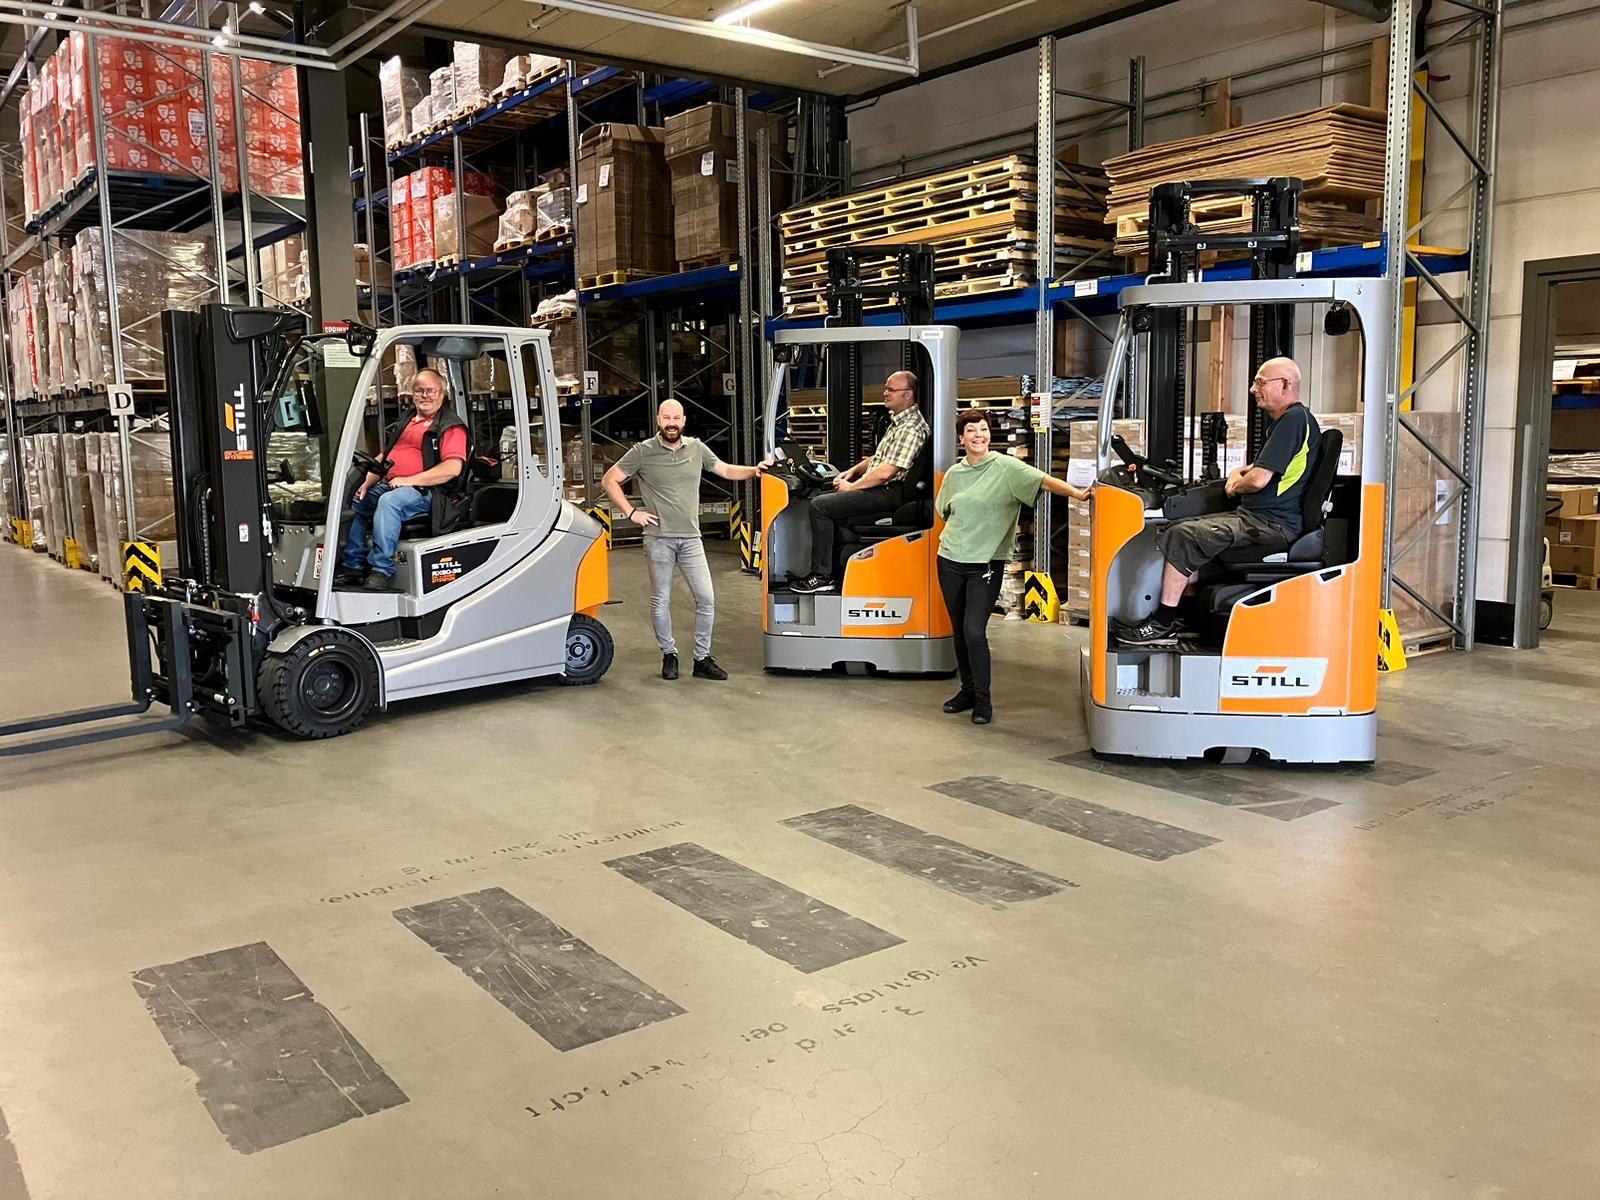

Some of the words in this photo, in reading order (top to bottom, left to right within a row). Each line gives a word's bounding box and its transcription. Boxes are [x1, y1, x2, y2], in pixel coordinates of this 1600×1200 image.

[586, 377, 597, 390] F
[725, 378, 735, 391] G
[114, 392, 131, 409] D
[233, 383, 248, 450] STILL
[431, 561, 462, 570] STILL
[848, 609, 902, 618] STILL
[1231, 675, 1310, 687] STILL
